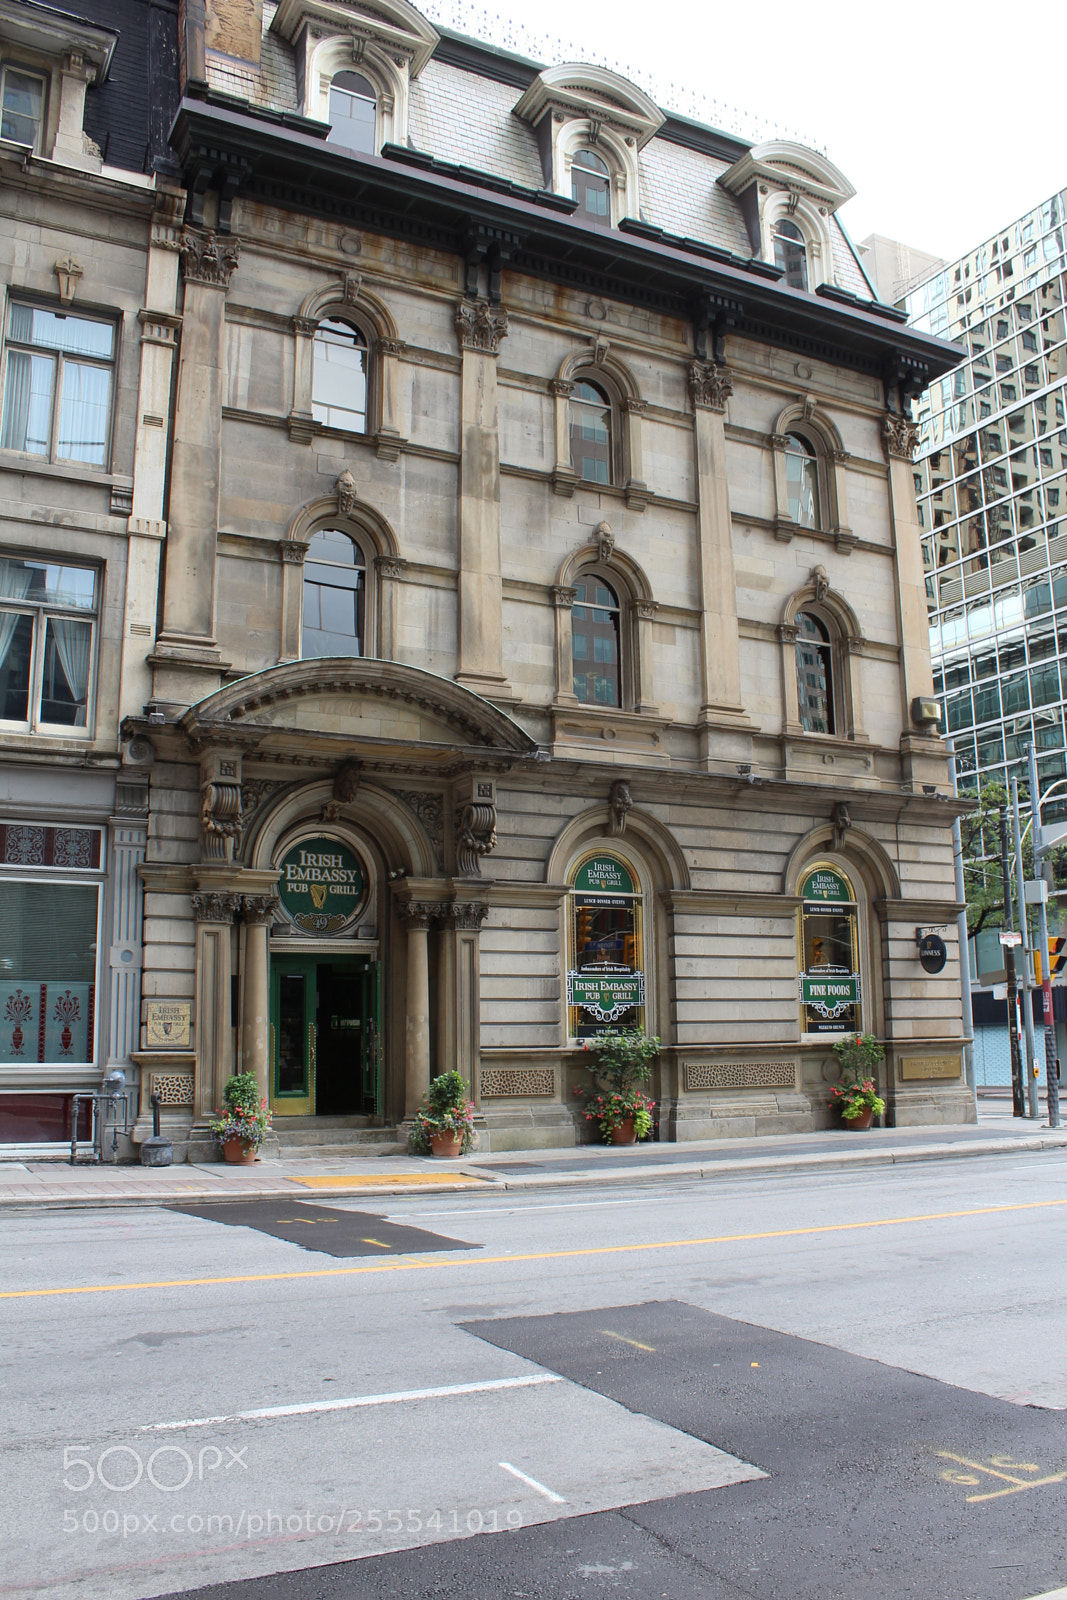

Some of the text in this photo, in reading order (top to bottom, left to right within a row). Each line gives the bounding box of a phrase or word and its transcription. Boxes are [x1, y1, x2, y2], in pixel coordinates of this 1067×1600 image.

[300, 850, 343, 868] IRISH
[594, 862, 615, 872] IRISH
[285, 864, 357, 883] EMBASSY
[587, 869, 622, 880] EMBASSY
[816, 874, 834, 883] IRISH
[287, 883, 358, 895] PUB GRILL
[811, 880, 840, 890] EMBASSY
[313, 916, 328, 929] 49
[575, 980, 638, 991] IRISH EMBASSY
[809, 985, 851, 996] FINE FOODS
[585, 992, 601, 1000] PUB
[159, 1006, 180, 1014] IRISH
[152, 1013, 187, 1021] EMBASSY
